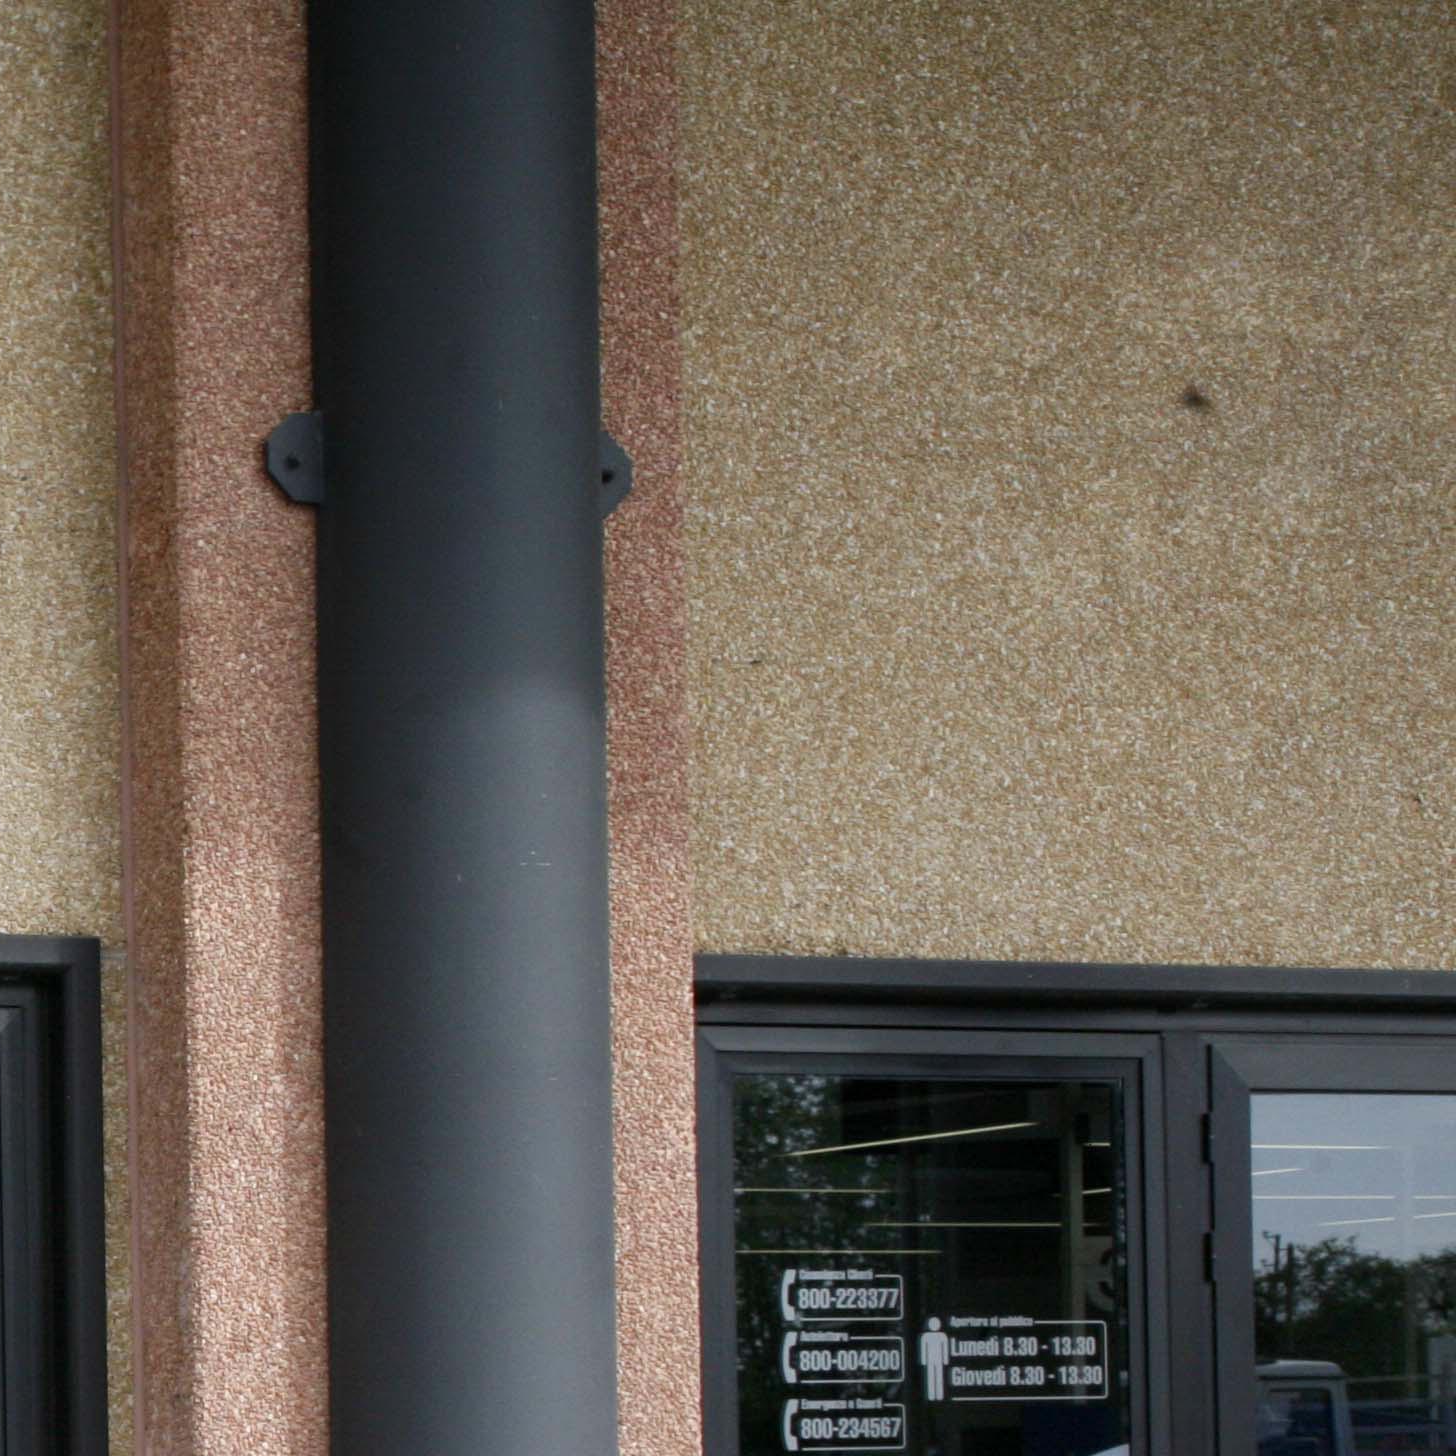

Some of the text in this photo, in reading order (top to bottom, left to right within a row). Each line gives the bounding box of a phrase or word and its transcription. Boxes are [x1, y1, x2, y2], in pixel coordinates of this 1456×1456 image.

[798, 1288, 899, 1309] 800-223377
[1003, 1336, 1038, 1356] 8.30
[1052, 1336, 1096, 1356] 13.30
[799, 1350, 900, 1372] 800-004200
[1009, 1365, 1045, 1385] 8.30
[1059, 1365, 1103, 1385] 13.30
[800, 1417, 902, 1439] 800-234567
